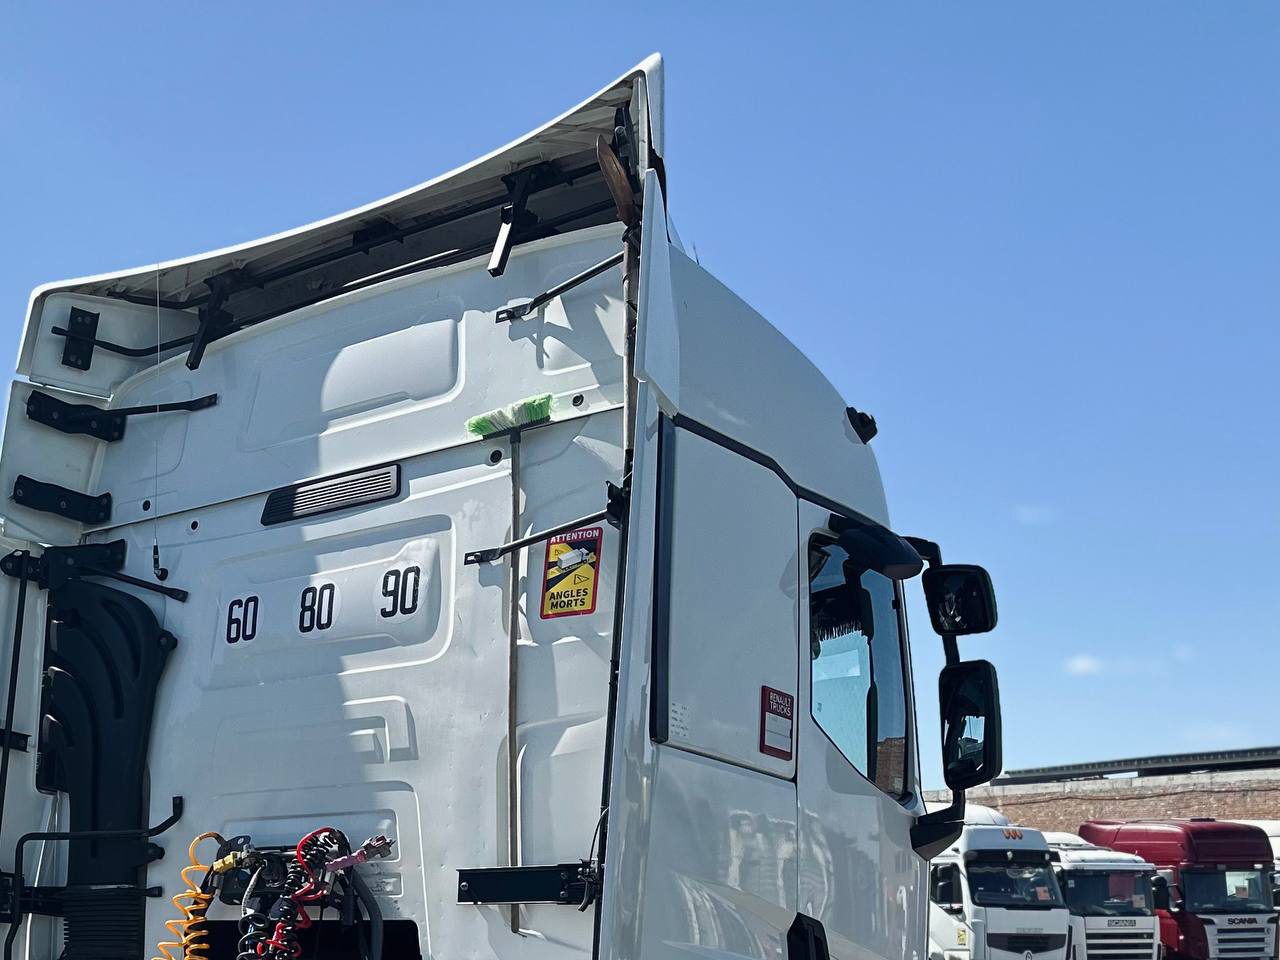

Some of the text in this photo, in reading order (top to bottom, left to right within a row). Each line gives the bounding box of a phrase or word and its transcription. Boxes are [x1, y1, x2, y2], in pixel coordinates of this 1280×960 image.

[550, 529, 600, 543] ATTENTION
[549, 588, 589, 601] ANGLES
[226, 565, 420, 644] 60 80 90
[550, 598, 586, 610] MORTS
[769, 691, 791, 707] RENAULT
[770, 701, 791, 716] TRUCKS
[1227, 917, 1258, 925] SCANIA
